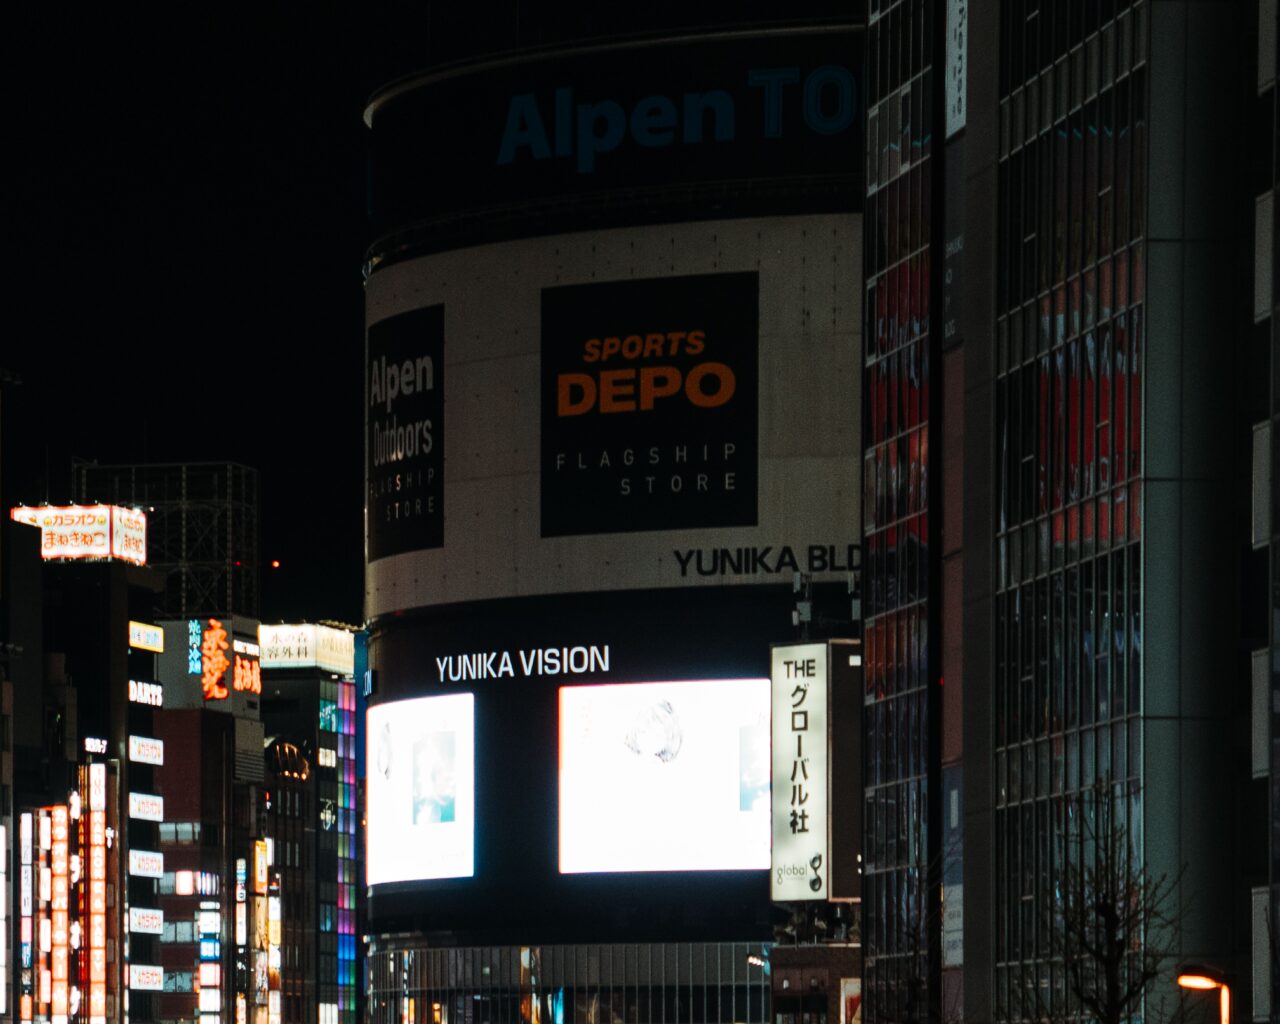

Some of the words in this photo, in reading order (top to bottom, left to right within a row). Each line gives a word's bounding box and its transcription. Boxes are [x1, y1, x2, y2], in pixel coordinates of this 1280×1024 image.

[497, 88, 736, 174] Alpen
[583, 330, 706, 362] SPORTS
[371, 354, 434, 413] Alpen
[557, 363, 736, 417] DEPO
[374, 416, 433, 468] Outdoors
[556, 443, 736, 471] FLAGSHIP
[621, 473, 736, 496] STORE
[53, 514, 97, 526] カラオケ
[386, 497, 435, 521] STORE
[44, 530, 106, 549] まねきねこ
[674, 546, 799, 577] YUNIKA
[436, 652, 514, 683] YUNIKA
[519, 645, 610, 677] VISION
[783, 659, 816, 678] THE
[129, 680, 163, 707] DARTS
[789, 684, 810, 835] グローバル社
[776, 864, 808, 885] global
